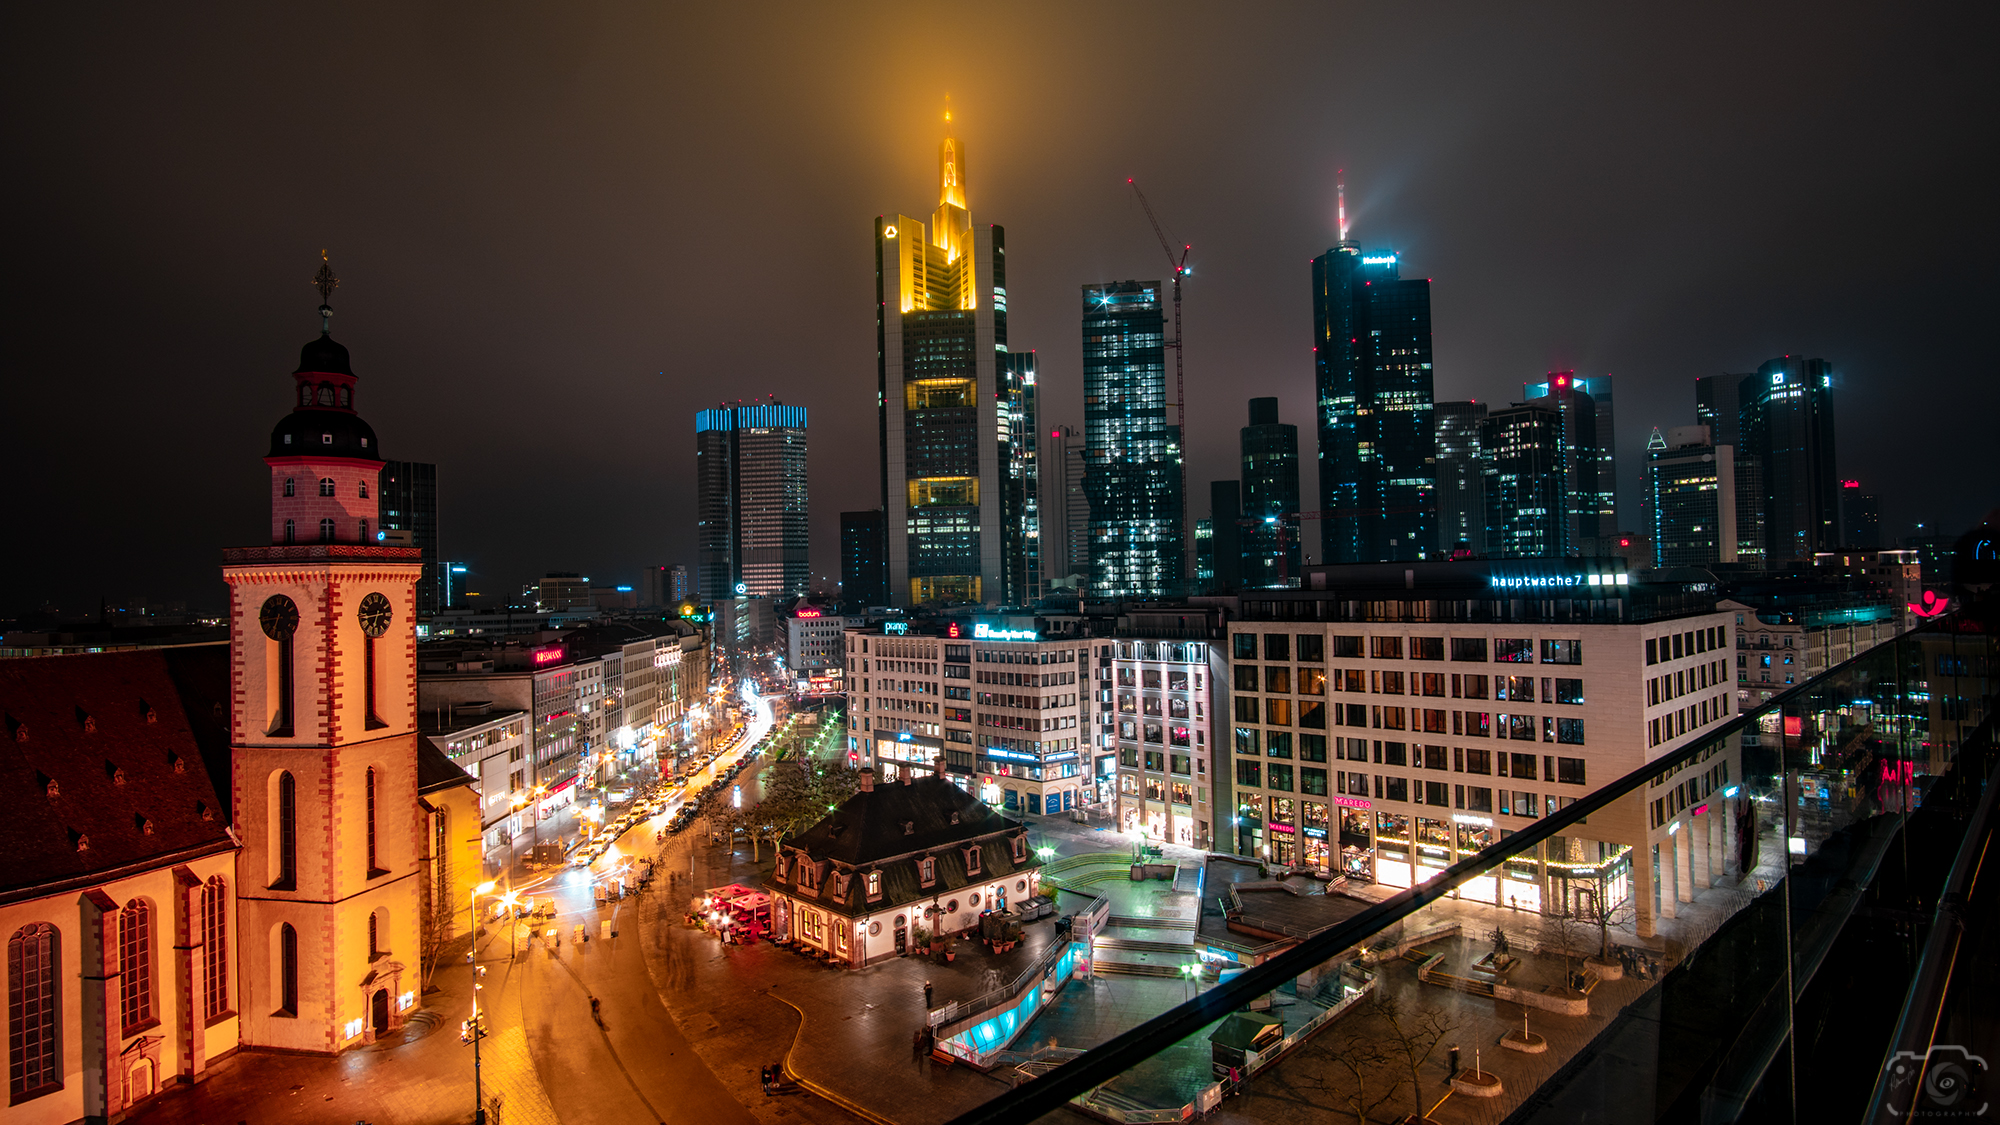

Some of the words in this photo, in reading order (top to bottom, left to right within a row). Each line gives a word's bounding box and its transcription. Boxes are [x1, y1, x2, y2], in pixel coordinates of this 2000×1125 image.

[798, 610, 820, 618] bodum
[1333, 796, 1372, 809] MAREDO
[1269, 823, 1296, 833] MAREDO
